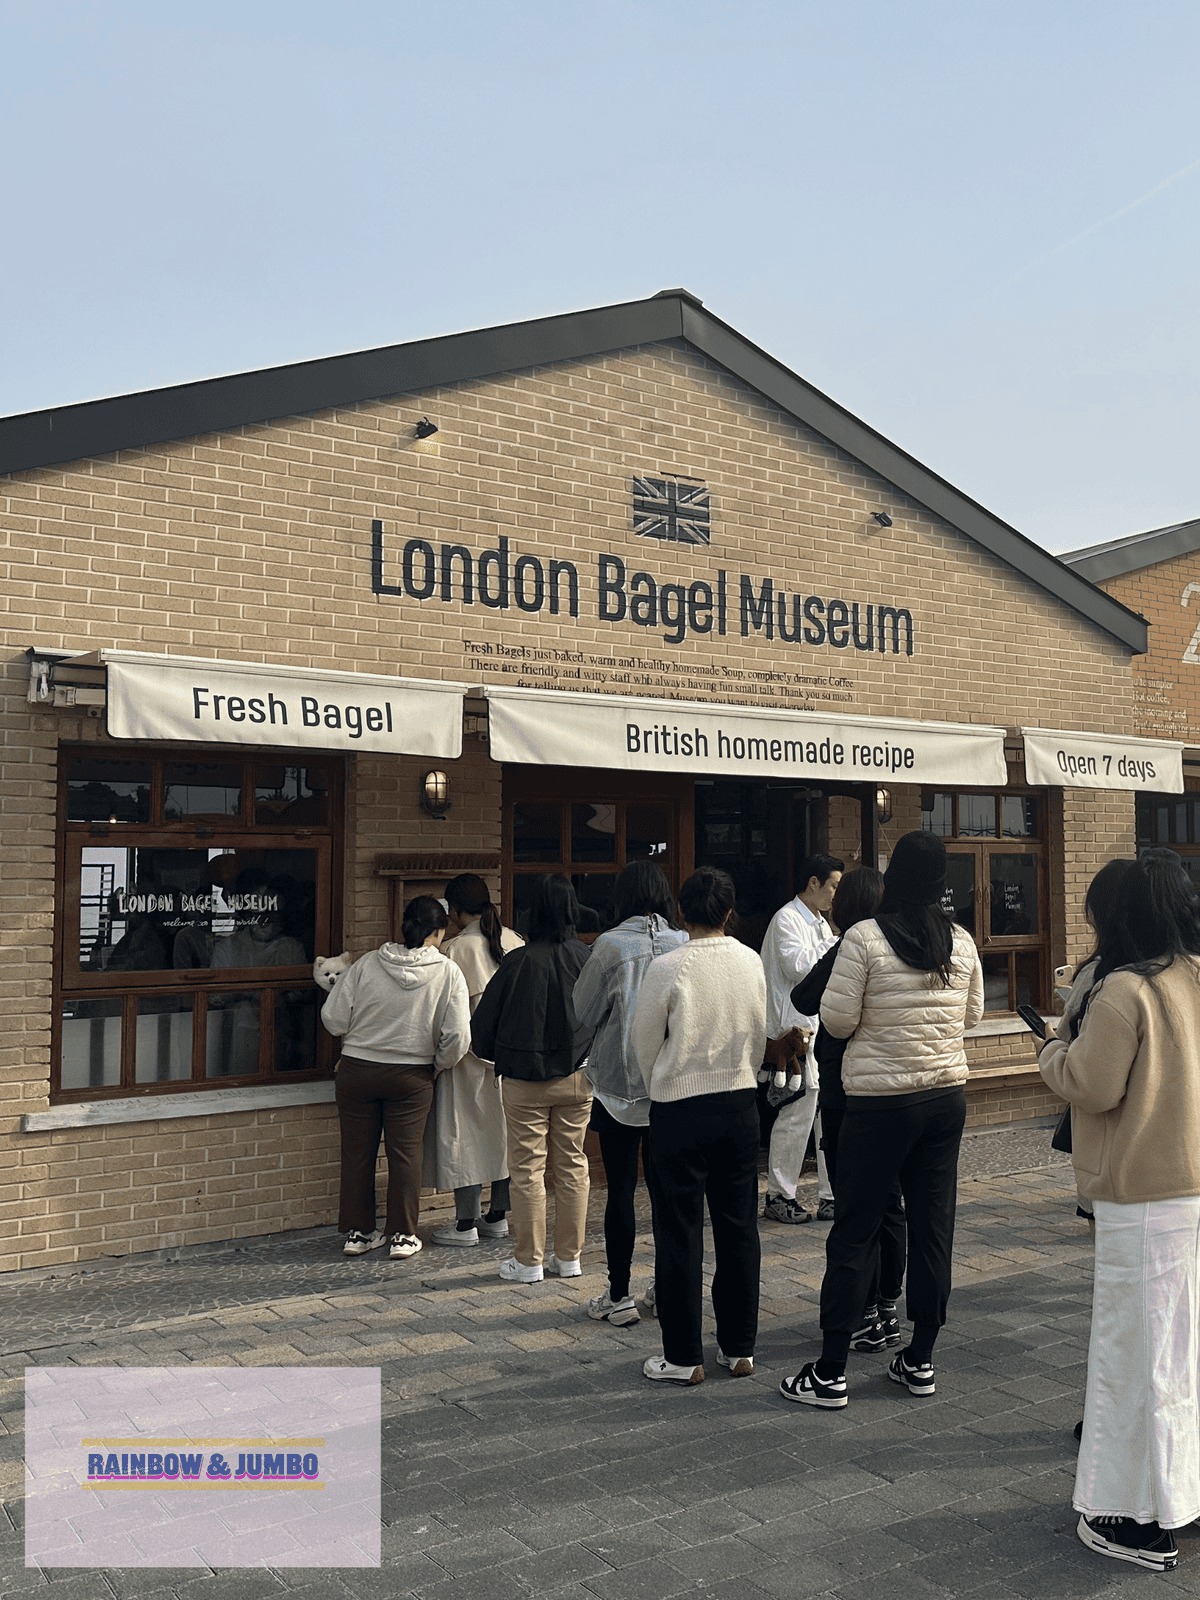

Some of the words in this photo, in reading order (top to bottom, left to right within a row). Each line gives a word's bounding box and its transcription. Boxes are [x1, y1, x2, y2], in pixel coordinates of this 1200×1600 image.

[371, 519, 579, 619] London
[598, 553, 727, 644] Bagel
[740, 575, 914, 657] Museum
[464, 641, 493, 654] Fresh
[496, 644, 531, 659] Bagels
[533, 647, 551, 661] just
[553, 649, 587, 664] baked,
[590, 655, 616, 666] warm
[618, 657, 635, 668] and
[638, 658, 671, 673] healthy
[672, 662, 720, 676] homemade
[721, 666, 746, 680] Soup,
[748, 671, 792, 684] completely
[793, 674, 827, 686] dramatic
[468, 658, 499, 671] There
[502, 663, 518, 673] are
[521, 663, 560, 679] friendly
[563, 667, 581, 679] and
[583, 669, 608, 683] witty
[610, 672, 631, 683] staff
[633, 674, 653, 685] who
[655, 675, 686, 690] always
[688, 678, 717, 692] having
[719, 681, 733, 692] fun
[735, 684, 757, 694] small
[759, 685, 777, 696] talk.
[779, 686, 804, 698] Thank
[805, 690, 820, 701] you
[821, 691, 831, 700] so
[832, 692, 853, 702] much
[192, 687, 288, 726] Fresh
[302, 697, 393, 738] Bagel
[626, 723, 711, 757] British
[717, 729, 845, 765] homemade
[852, 743, 915, 771] recipe
[1057, 750, 1097, 779] Open
[1102, 756, 1112, 776] 7
[1118, 755, 1156, 782] days
[119, 893, 173, 914] LONDON
